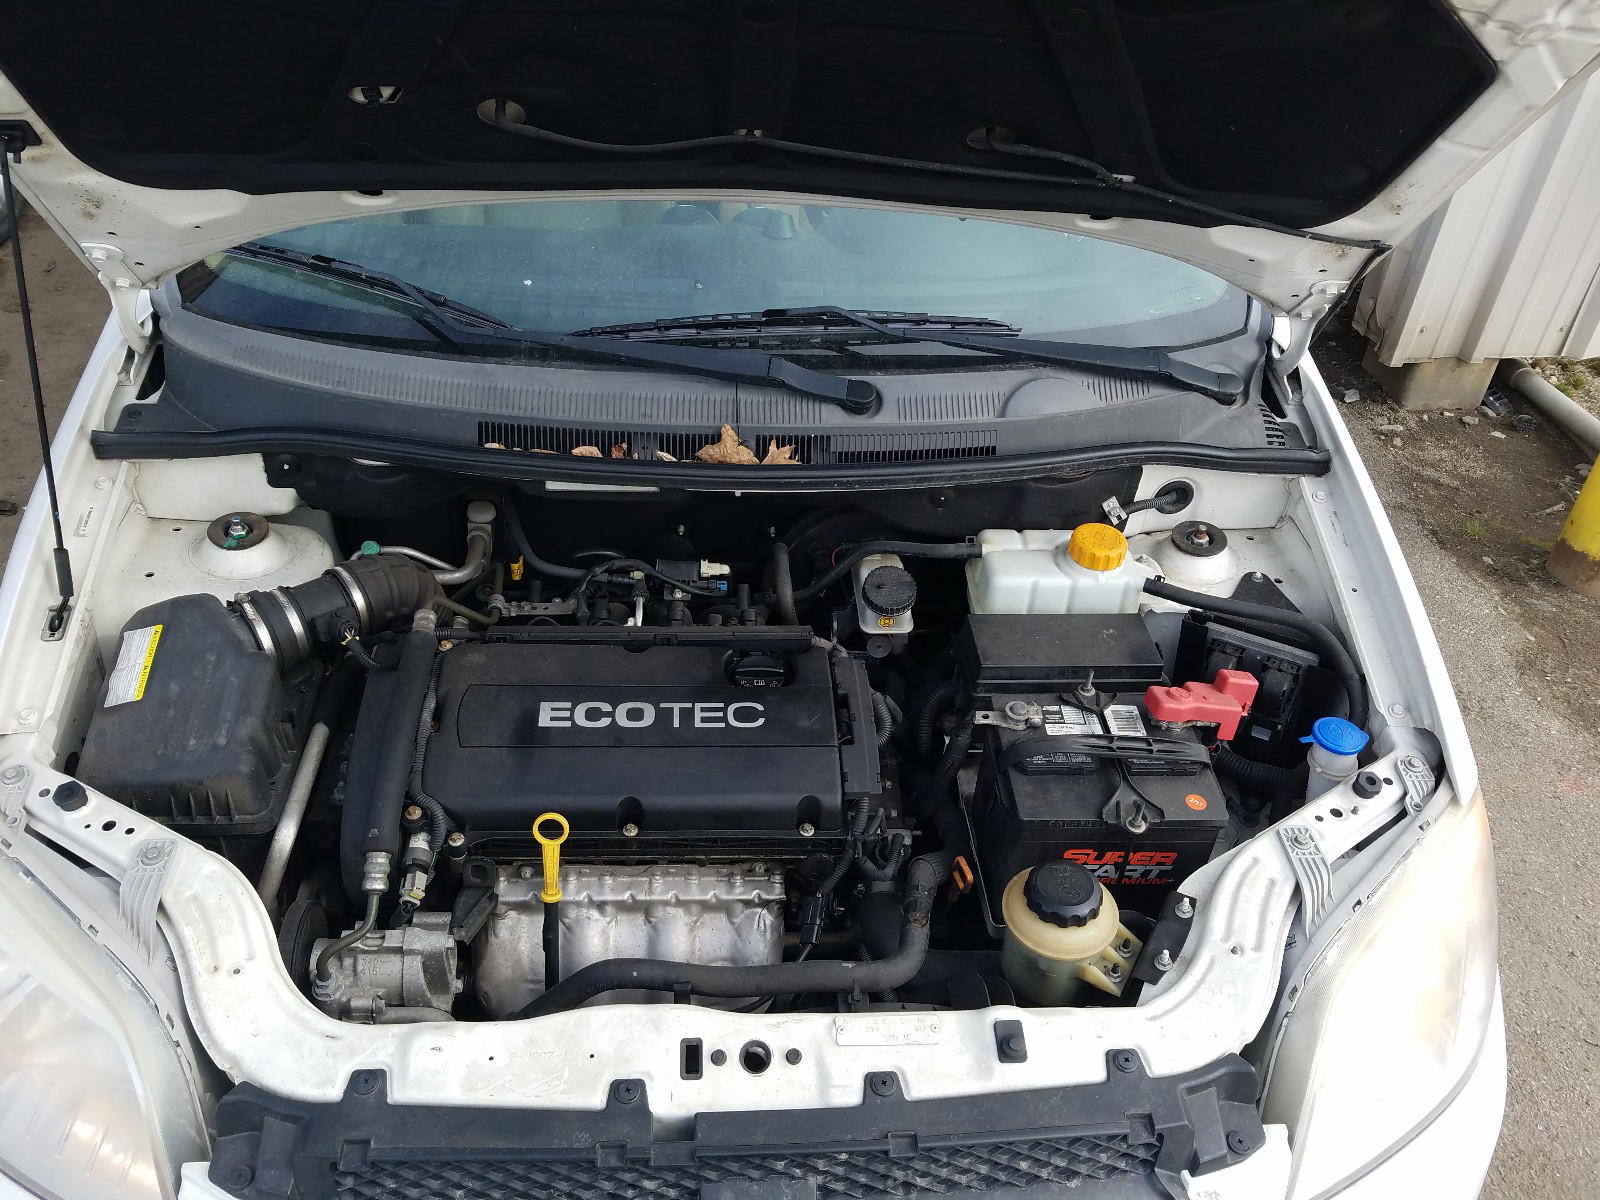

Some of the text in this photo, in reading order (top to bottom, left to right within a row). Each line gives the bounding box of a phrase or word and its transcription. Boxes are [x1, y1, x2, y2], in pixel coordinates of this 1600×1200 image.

[538, 701, 766, 728] ECOTEC
[1063, 849, 1177, 865] SUPER
[1084, 864, 1174, 879] ART
[1098, 877, 1168, 885] REMIUM
